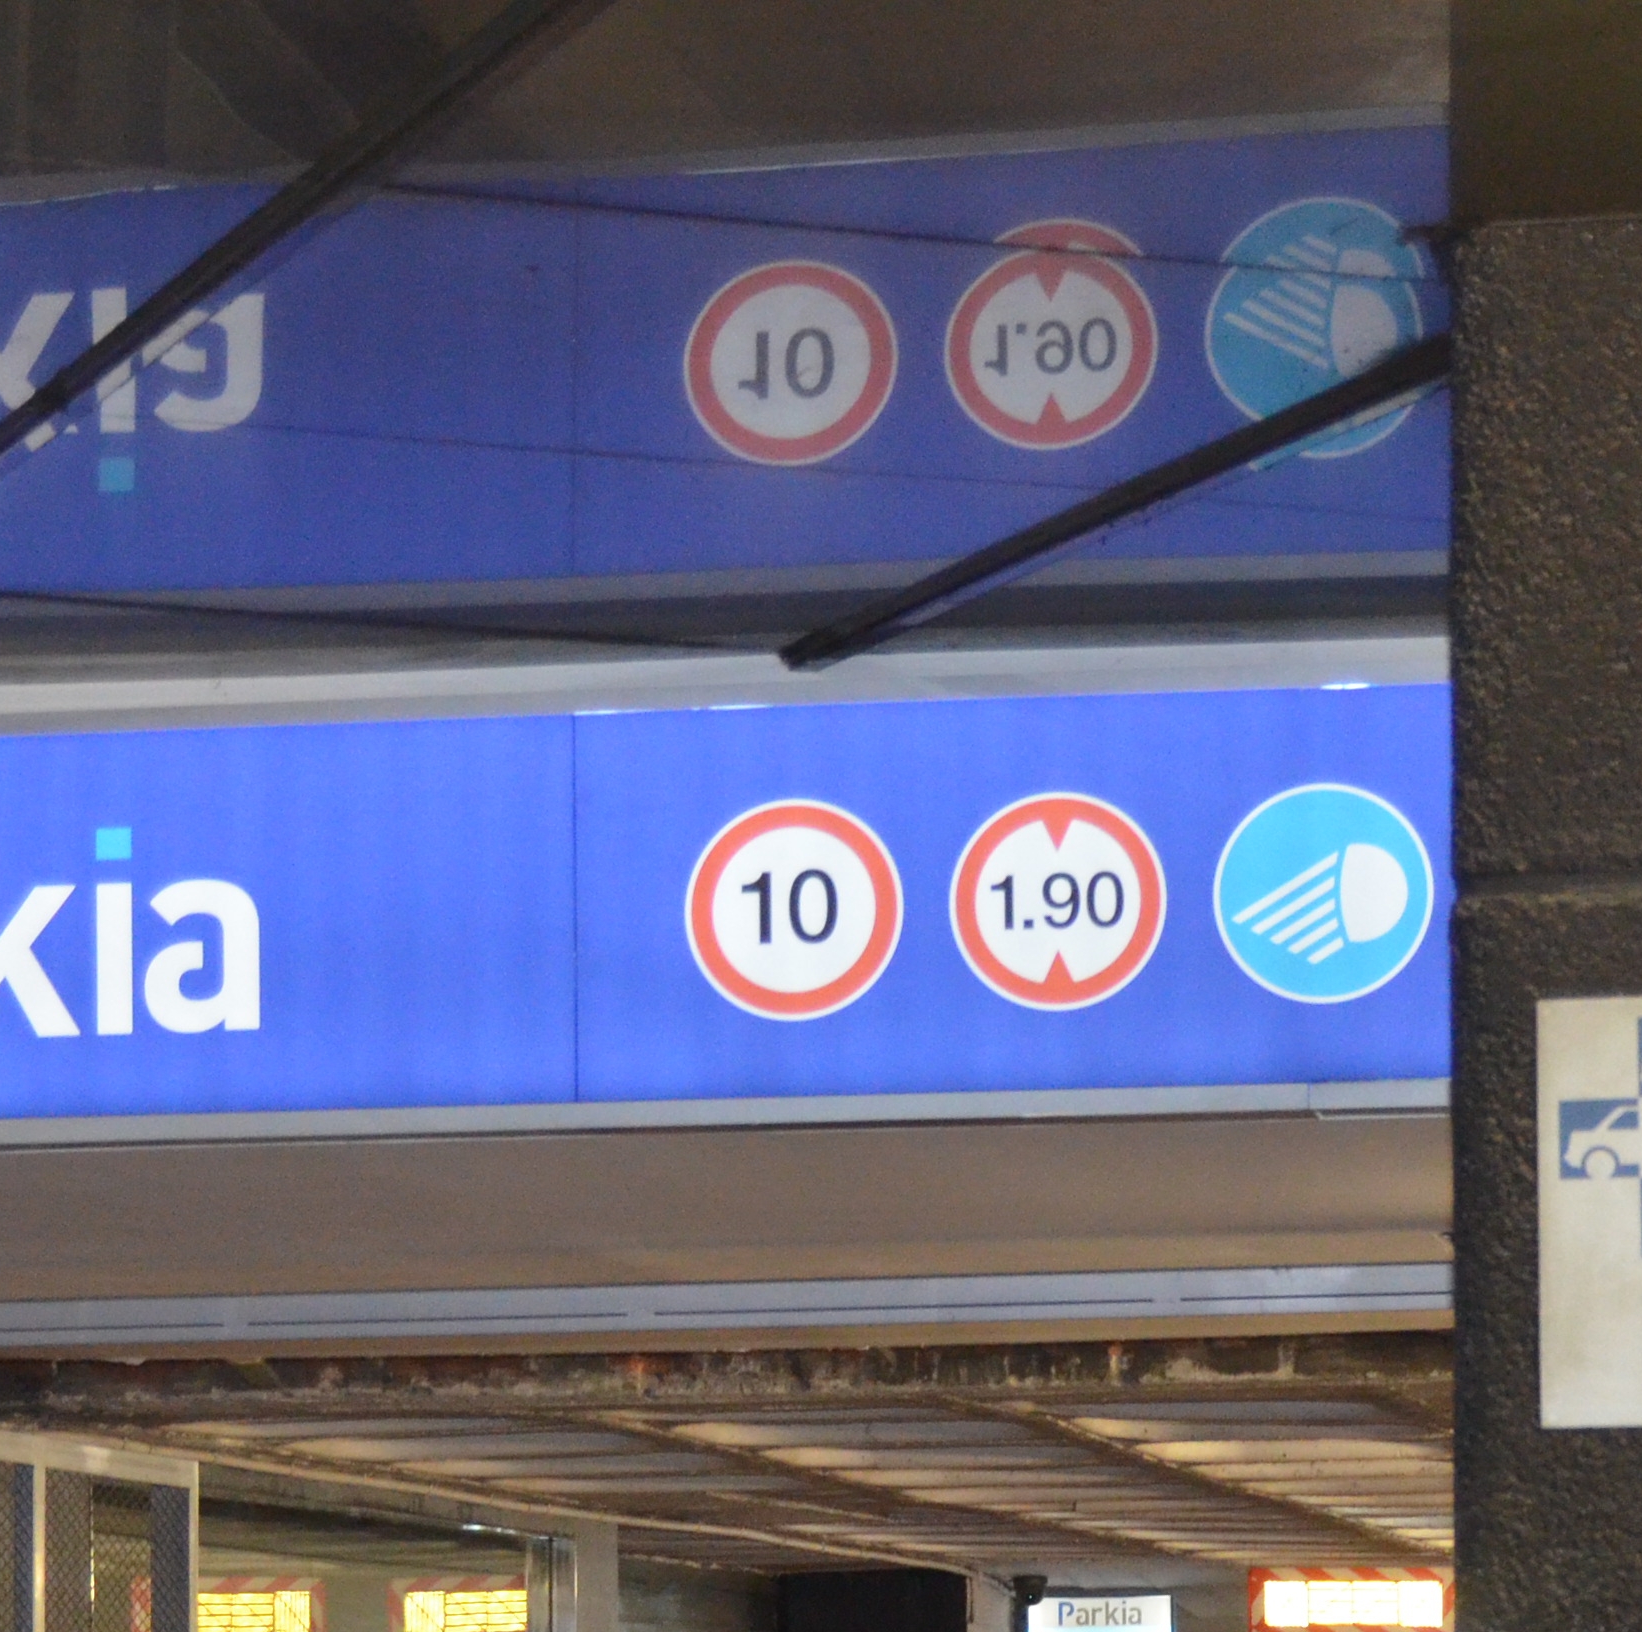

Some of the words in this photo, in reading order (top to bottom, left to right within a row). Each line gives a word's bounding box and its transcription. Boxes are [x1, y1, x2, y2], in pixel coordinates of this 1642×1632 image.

[740, 866, 839, 947] 10
[988, 868, 1126, 932] 1.90
[1058, 1599, 1143, 1627] Parkia
